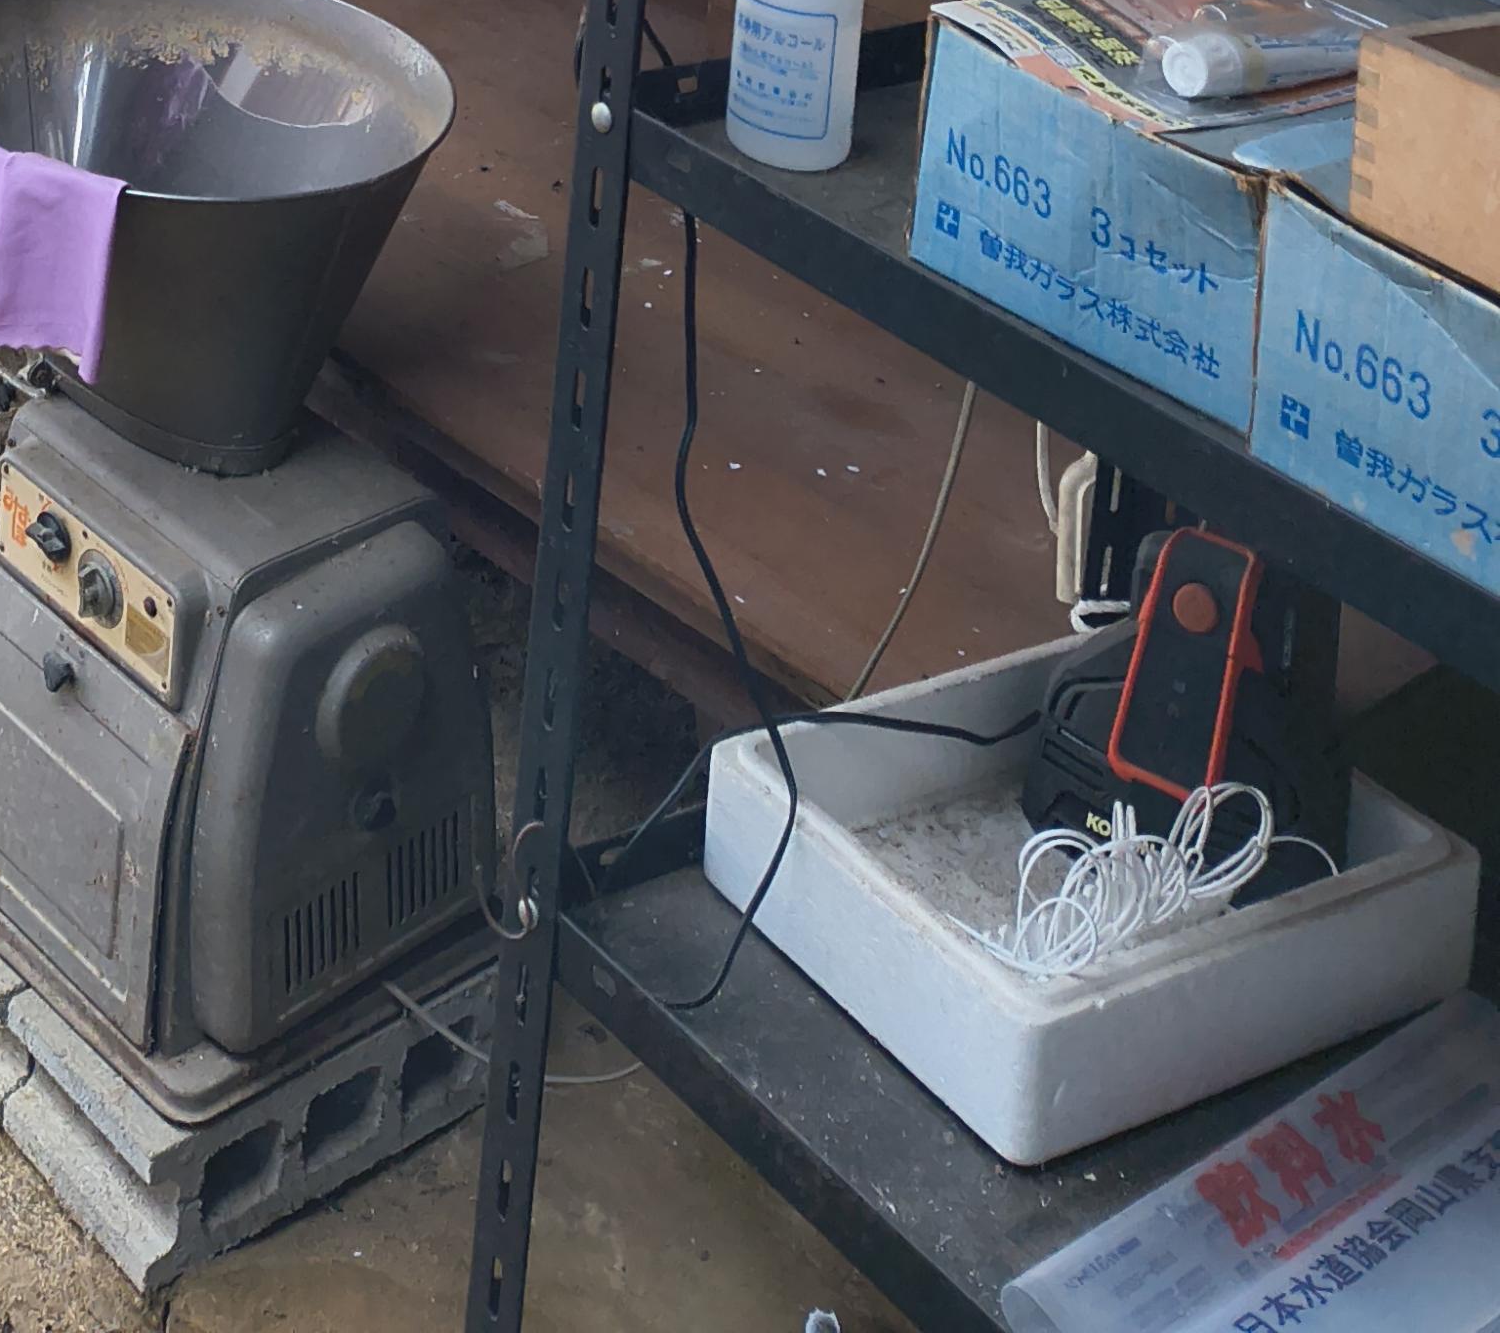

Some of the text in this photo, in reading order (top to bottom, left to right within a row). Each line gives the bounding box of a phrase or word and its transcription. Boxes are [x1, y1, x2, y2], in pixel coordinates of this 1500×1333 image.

[947, 127, 1051, 219] No.663
[1295, 309, 1432, 420] No.663
[1335, 428, 1500, 545] 曽我ガラス
[1194, 1090, 1387, 1247] 飲料水
